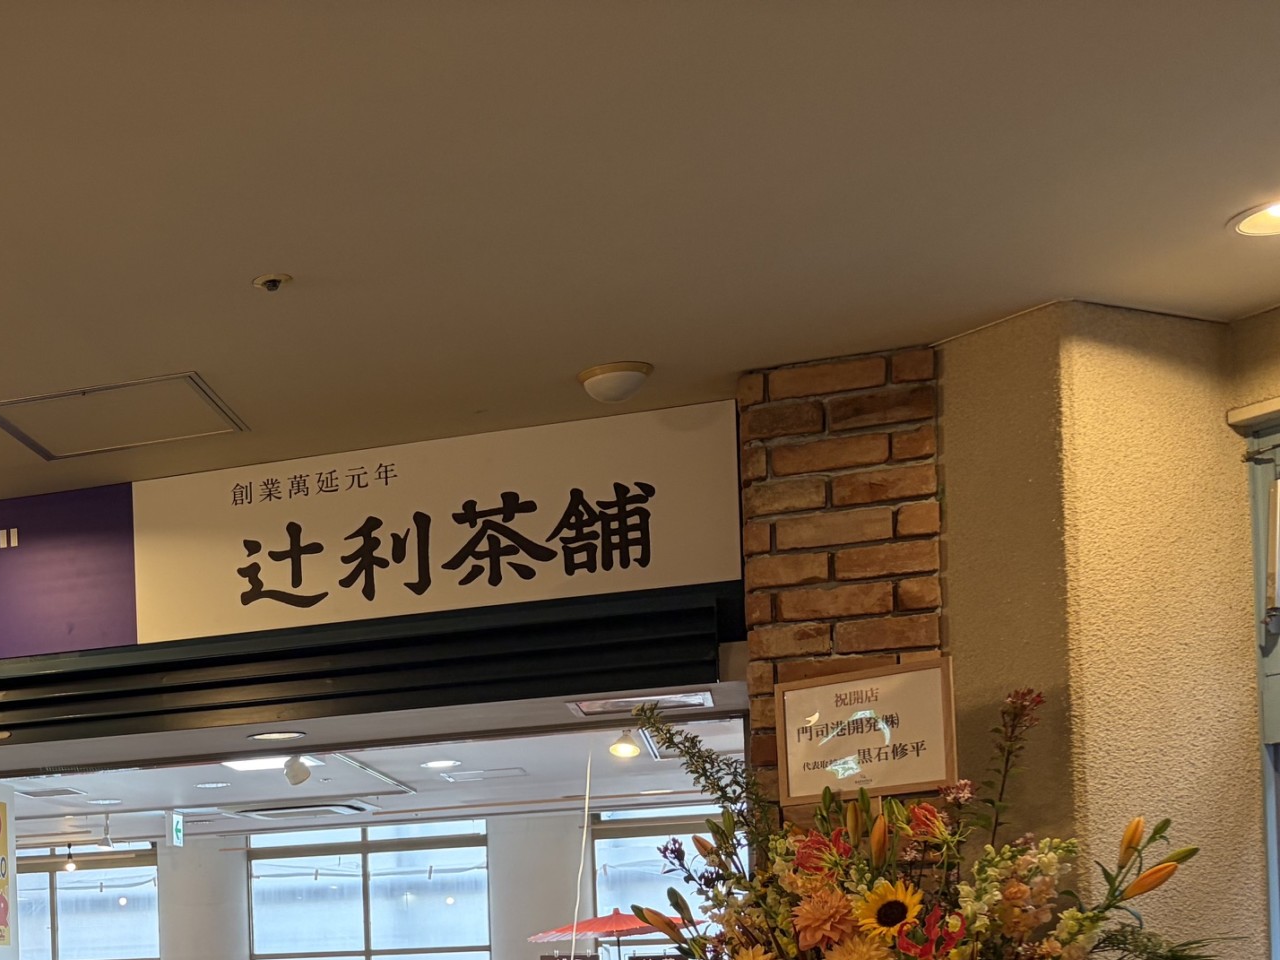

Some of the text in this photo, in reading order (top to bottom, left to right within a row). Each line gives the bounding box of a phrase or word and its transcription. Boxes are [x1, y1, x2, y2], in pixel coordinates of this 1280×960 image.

[231, 462, 398, 506] 創業萬延元年
[238, 481, 655, 608] 辻利茶舗
[834, 687, 879, 708] 祝開店
[857, 740, 927, 765] 黒石修平
